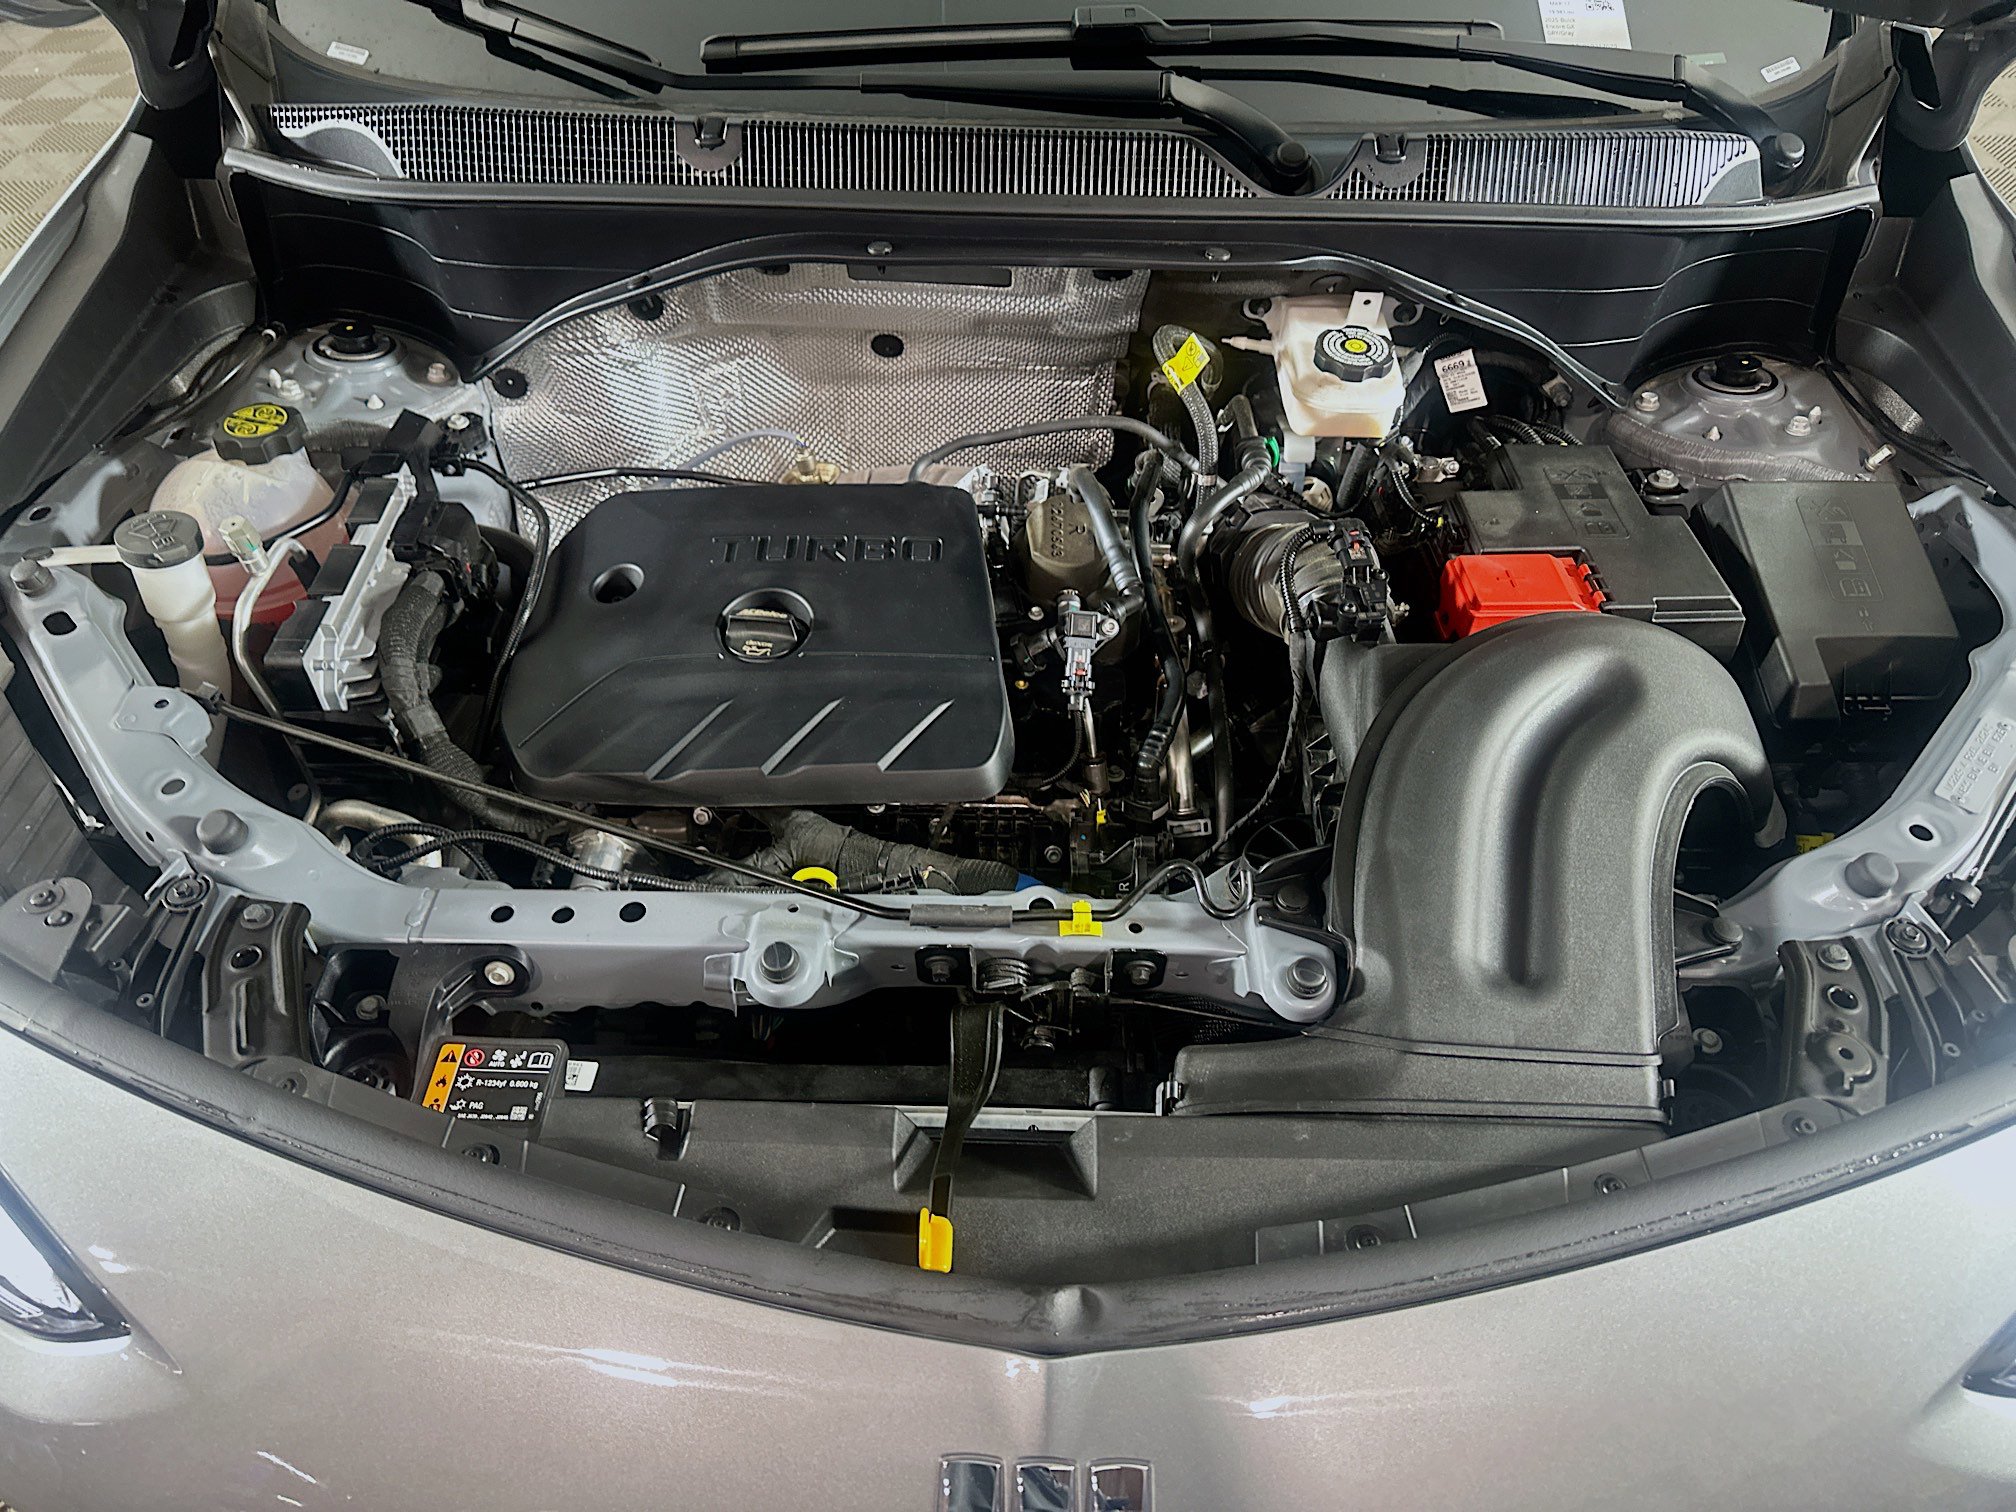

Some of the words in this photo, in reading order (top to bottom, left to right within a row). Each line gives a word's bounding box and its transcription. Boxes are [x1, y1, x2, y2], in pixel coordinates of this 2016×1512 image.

[711, 535, 944, 563] TURBO
[475, 1079, 507, 1089] R-1234yf
[468, 1102, 484, 1110] PAG
